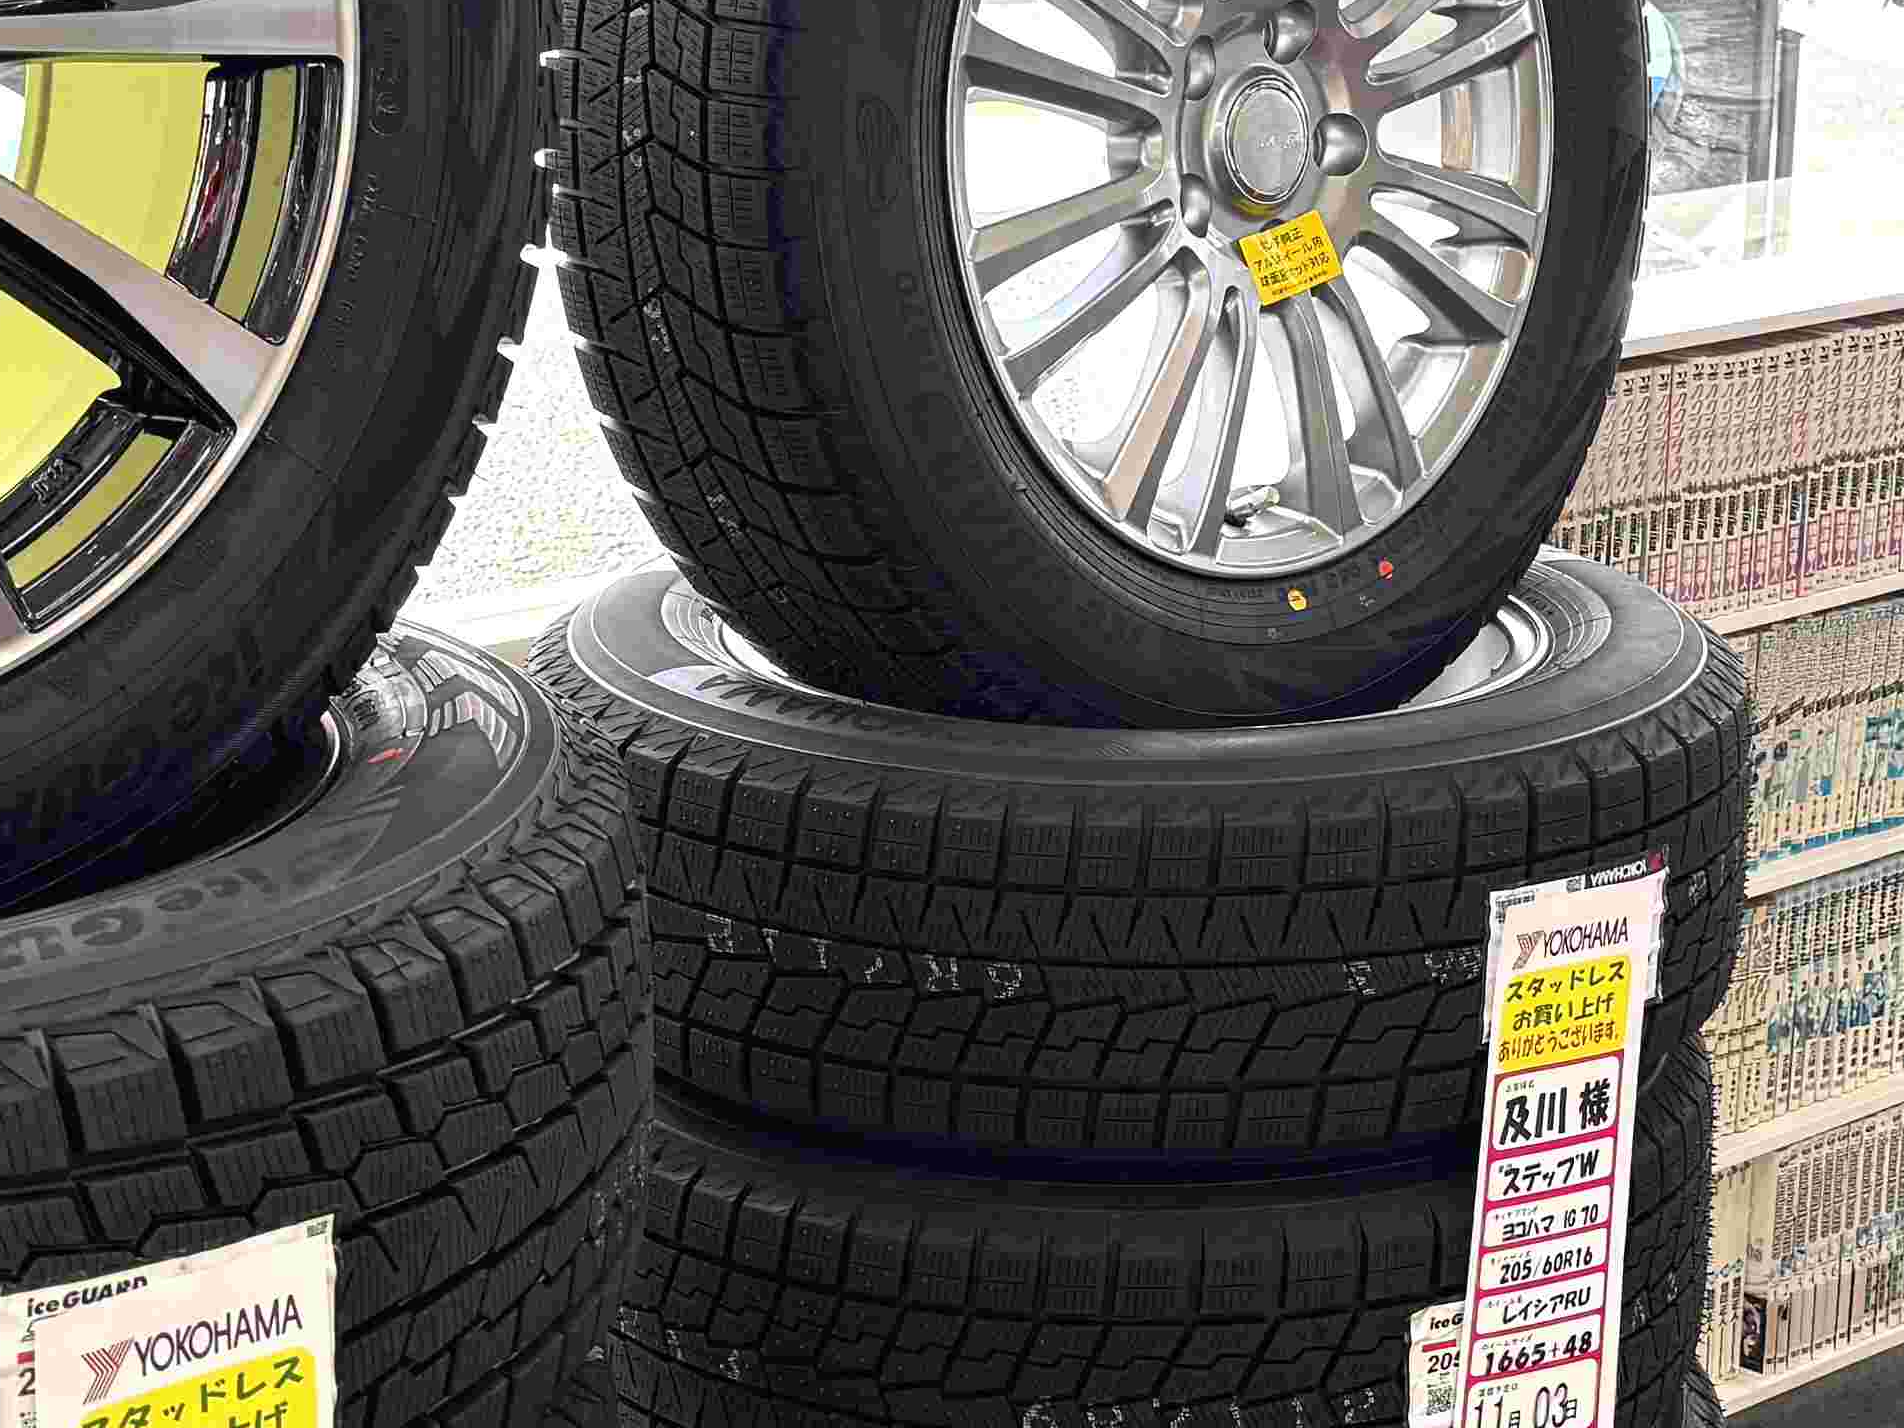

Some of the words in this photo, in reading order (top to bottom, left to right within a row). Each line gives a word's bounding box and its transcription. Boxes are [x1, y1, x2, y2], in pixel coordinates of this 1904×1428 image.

[1542, 916, 1629, 958] YOKOHAMA
[1506, 960, 1626, 1003] スタッドレス
[1512, 992, 1615, 1032] お買い上げ
[1499, 1086, 1568, 1146] 及川
[1501, 1215, 1555, 1243] ヨコハマ
[1499, 1246, 1594, 1286] 205/60R16
[133, 1293, 304, 1377] YOKOHAMA
